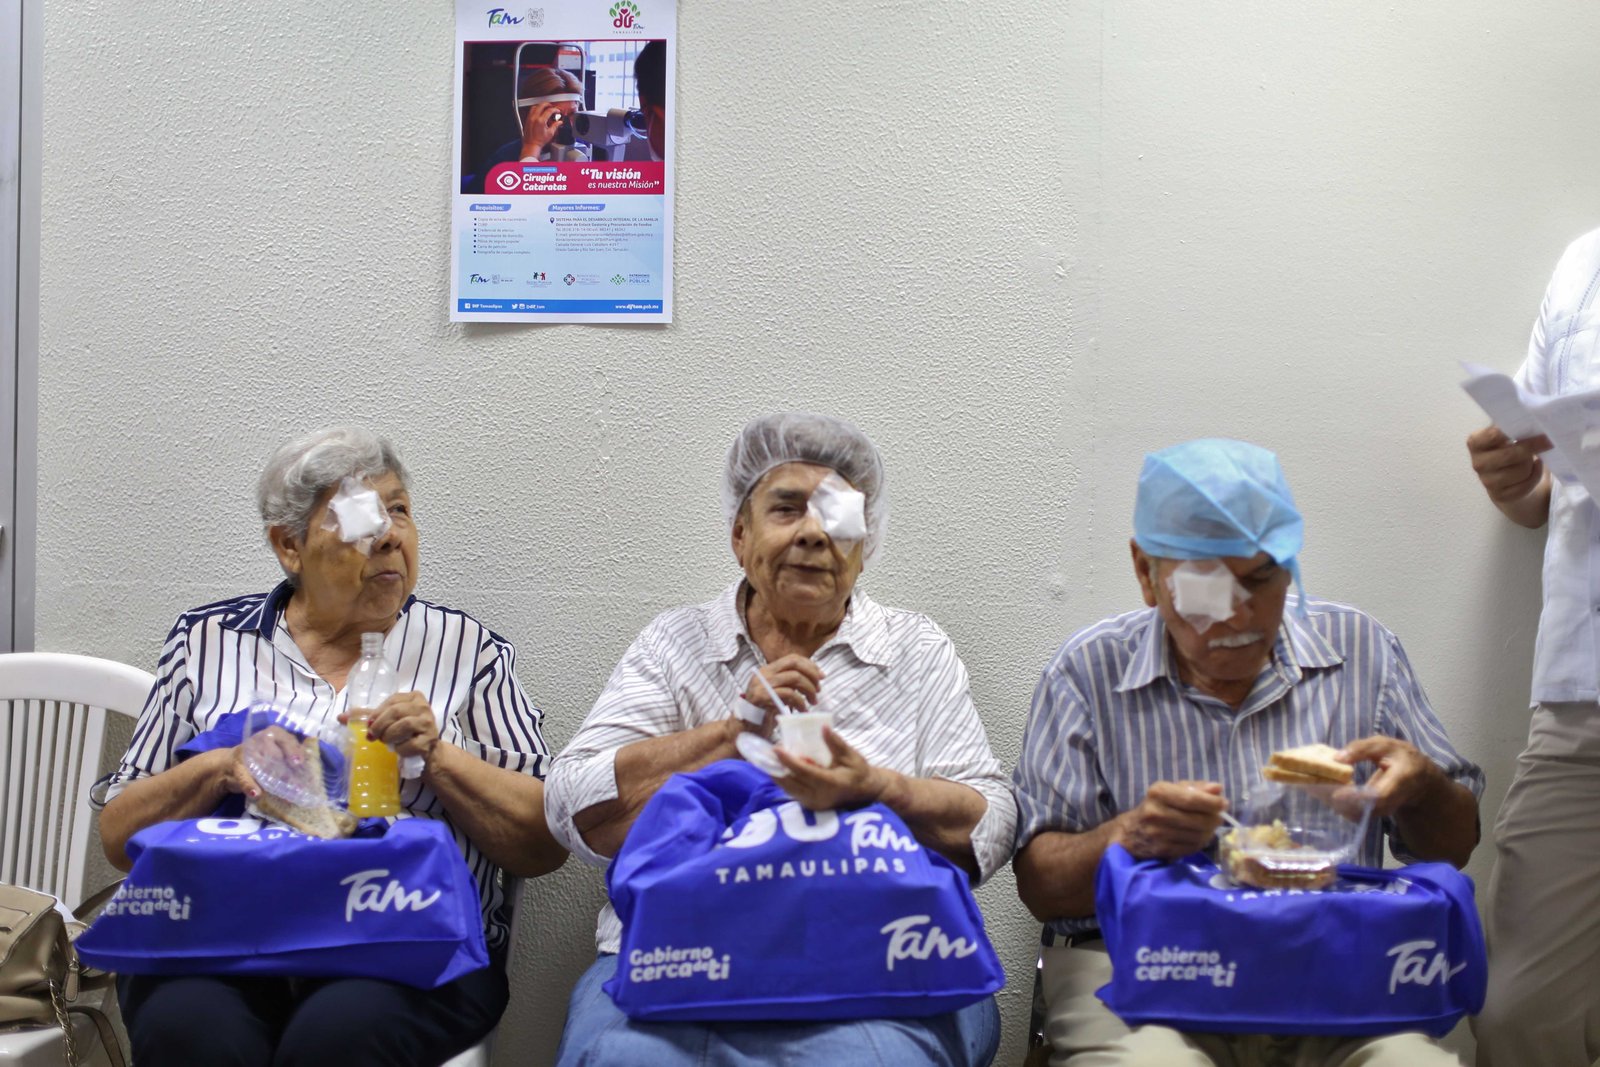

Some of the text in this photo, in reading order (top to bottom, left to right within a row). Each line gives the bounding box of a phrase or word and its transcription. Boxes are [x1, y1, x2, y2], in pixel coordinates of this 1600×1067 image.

[487, 8, 524, 28] Tam
[522, 173, 567, 184] Cirugía de
[598, 181, 627, 189] nuestra
[605, 168, 641, 180] visión
[522, 182, 567, 191] Cataratas
[843, 811, 919, 856] Tam
[715, 857, 907, 884] TAMAULIPAS
[340, 869, 442, 922] Tam
[100, 901, 154, 915] erca
[169, 896, 191, 920] ti
[880, 915, 978, 971] Tam
[629, 945, 713, 966] Gobierno
[1136, 945, 1220, 964] Gobierno
[630, 961, 693, 982] cerca
[707, 954, 730, 981] ti
[1135, 965, 1198, 981] cerca
[1212, 962, 1237, 987] ti
